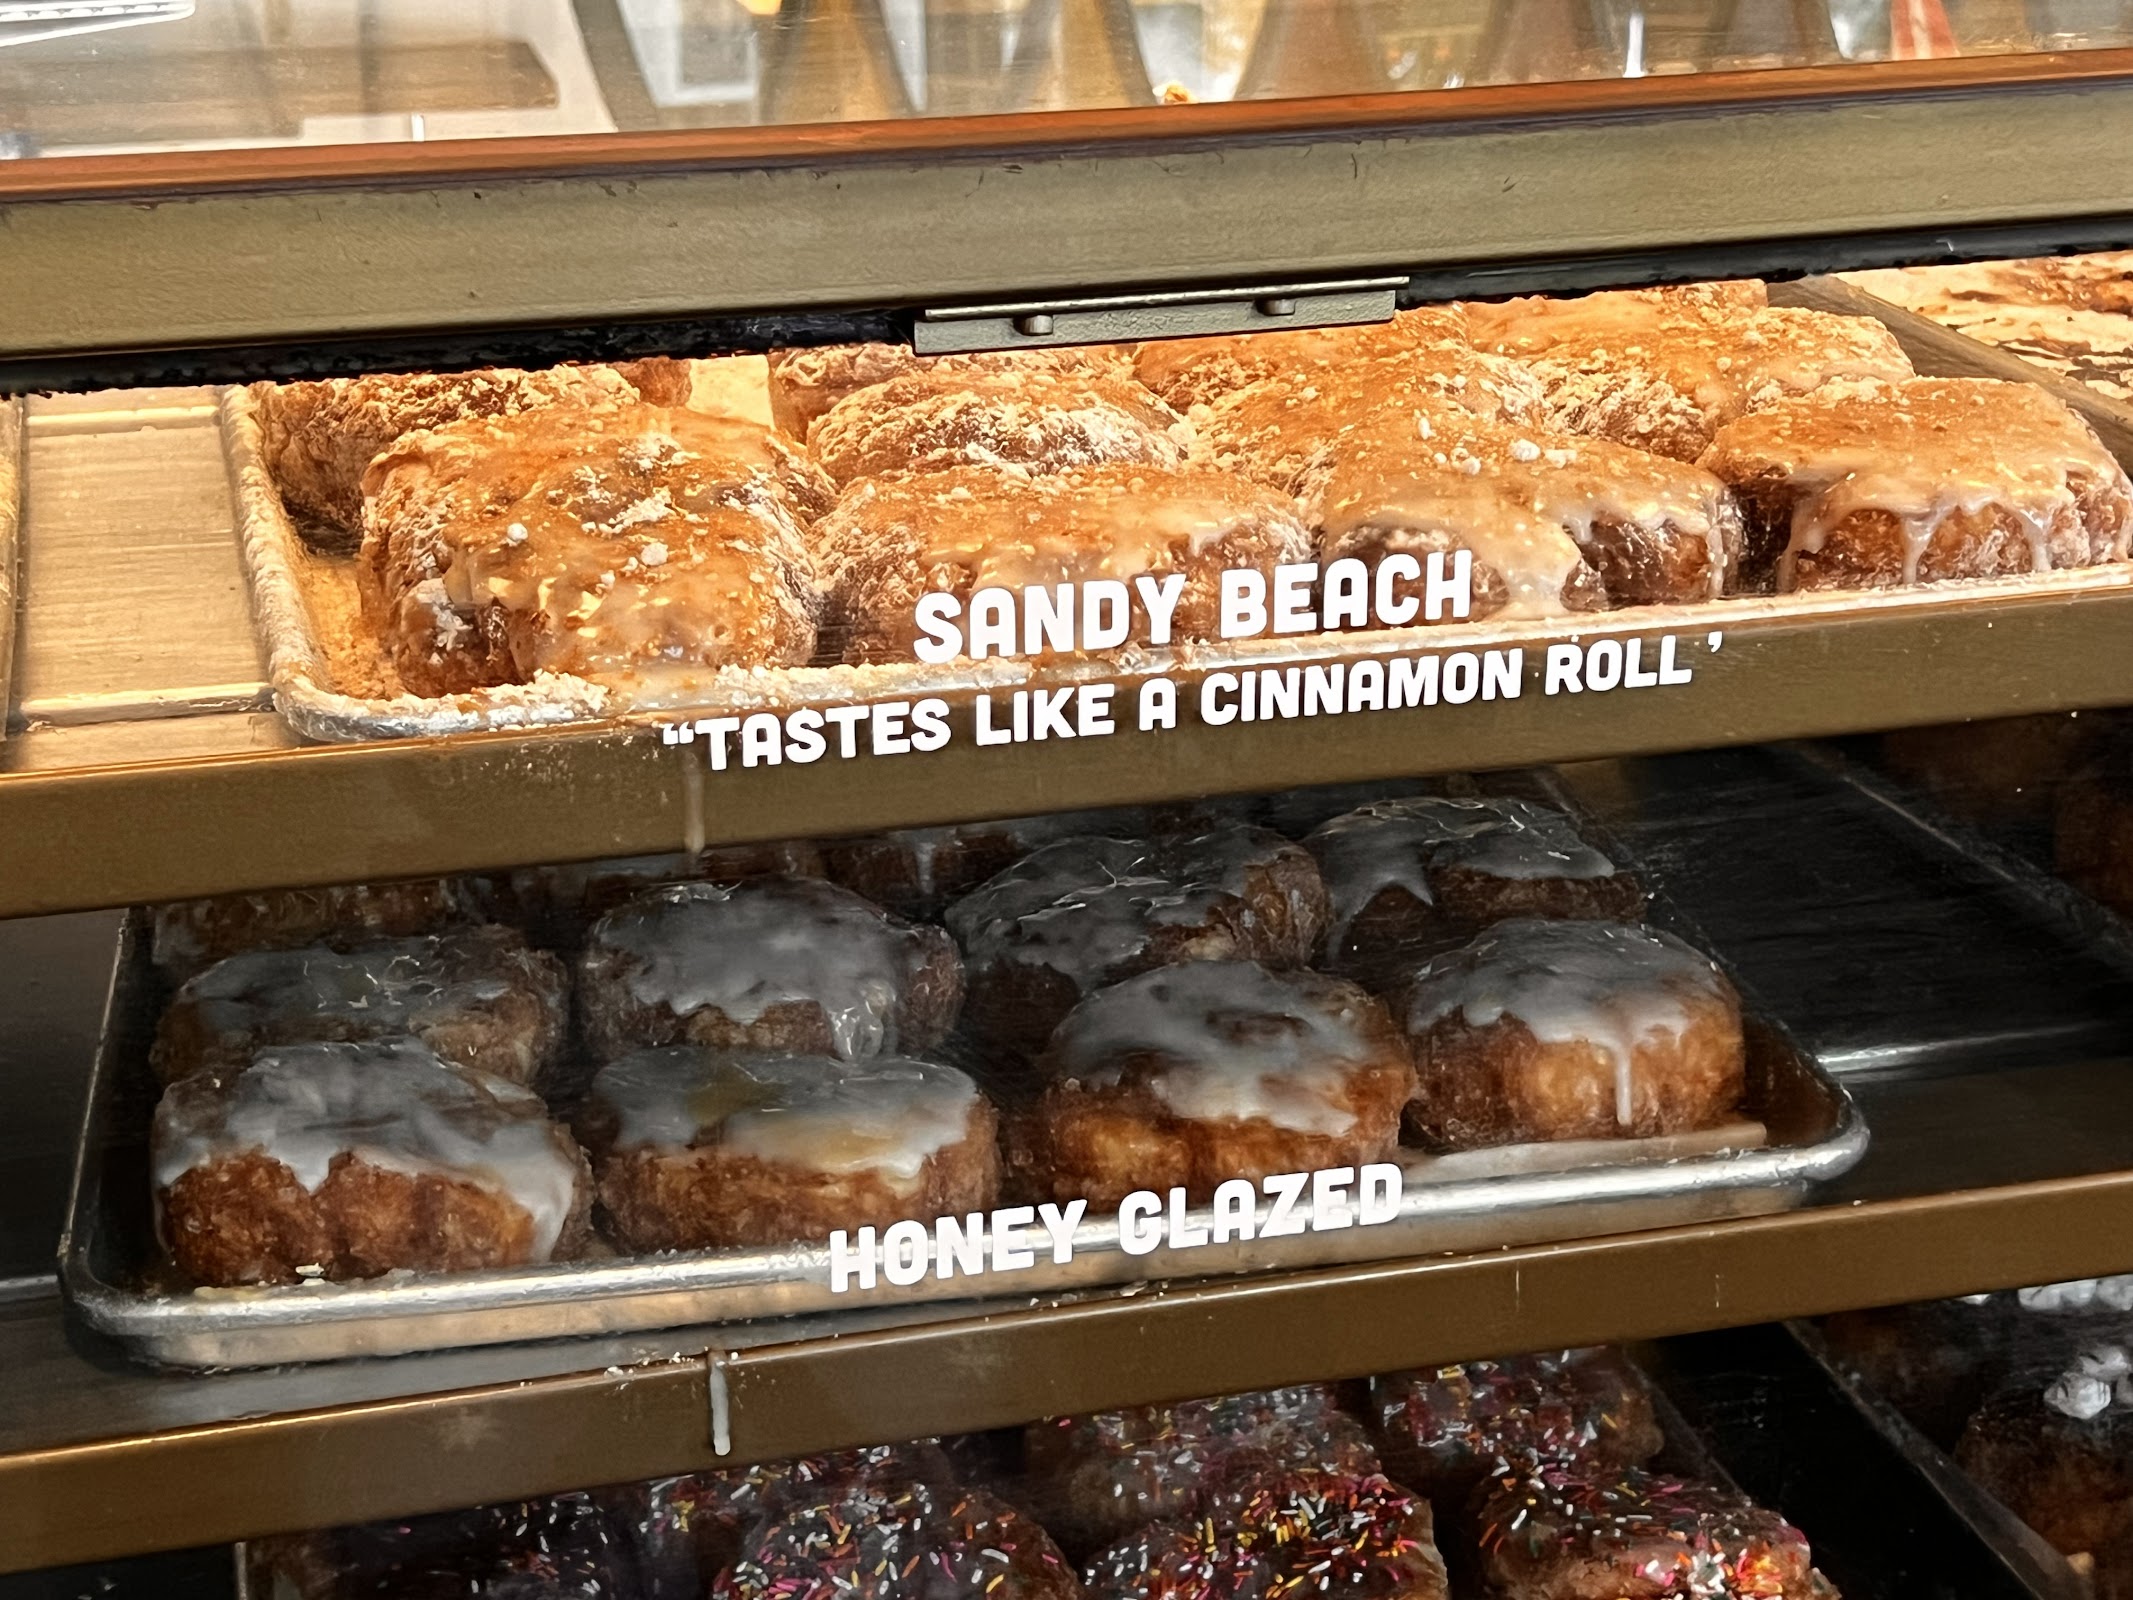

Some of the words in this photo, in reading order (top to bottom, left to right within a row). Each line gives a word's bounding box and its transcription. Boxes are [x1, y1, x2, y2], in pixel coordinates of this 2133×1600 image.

[913, 573, 1186, 664] SANDY
[1218, 549, 1472, 638] BEACH
[661, 698, 952, 770] “TASTES
[976, 683, 1116, 747] LIKE
[1138, 678, 1176, 731] A
[1201, 648, 1523, 725] CINNAMON
[829, 1198, 1088, 1293] HONEY
[1118, 1162, 1403, 1256] GLAZED
